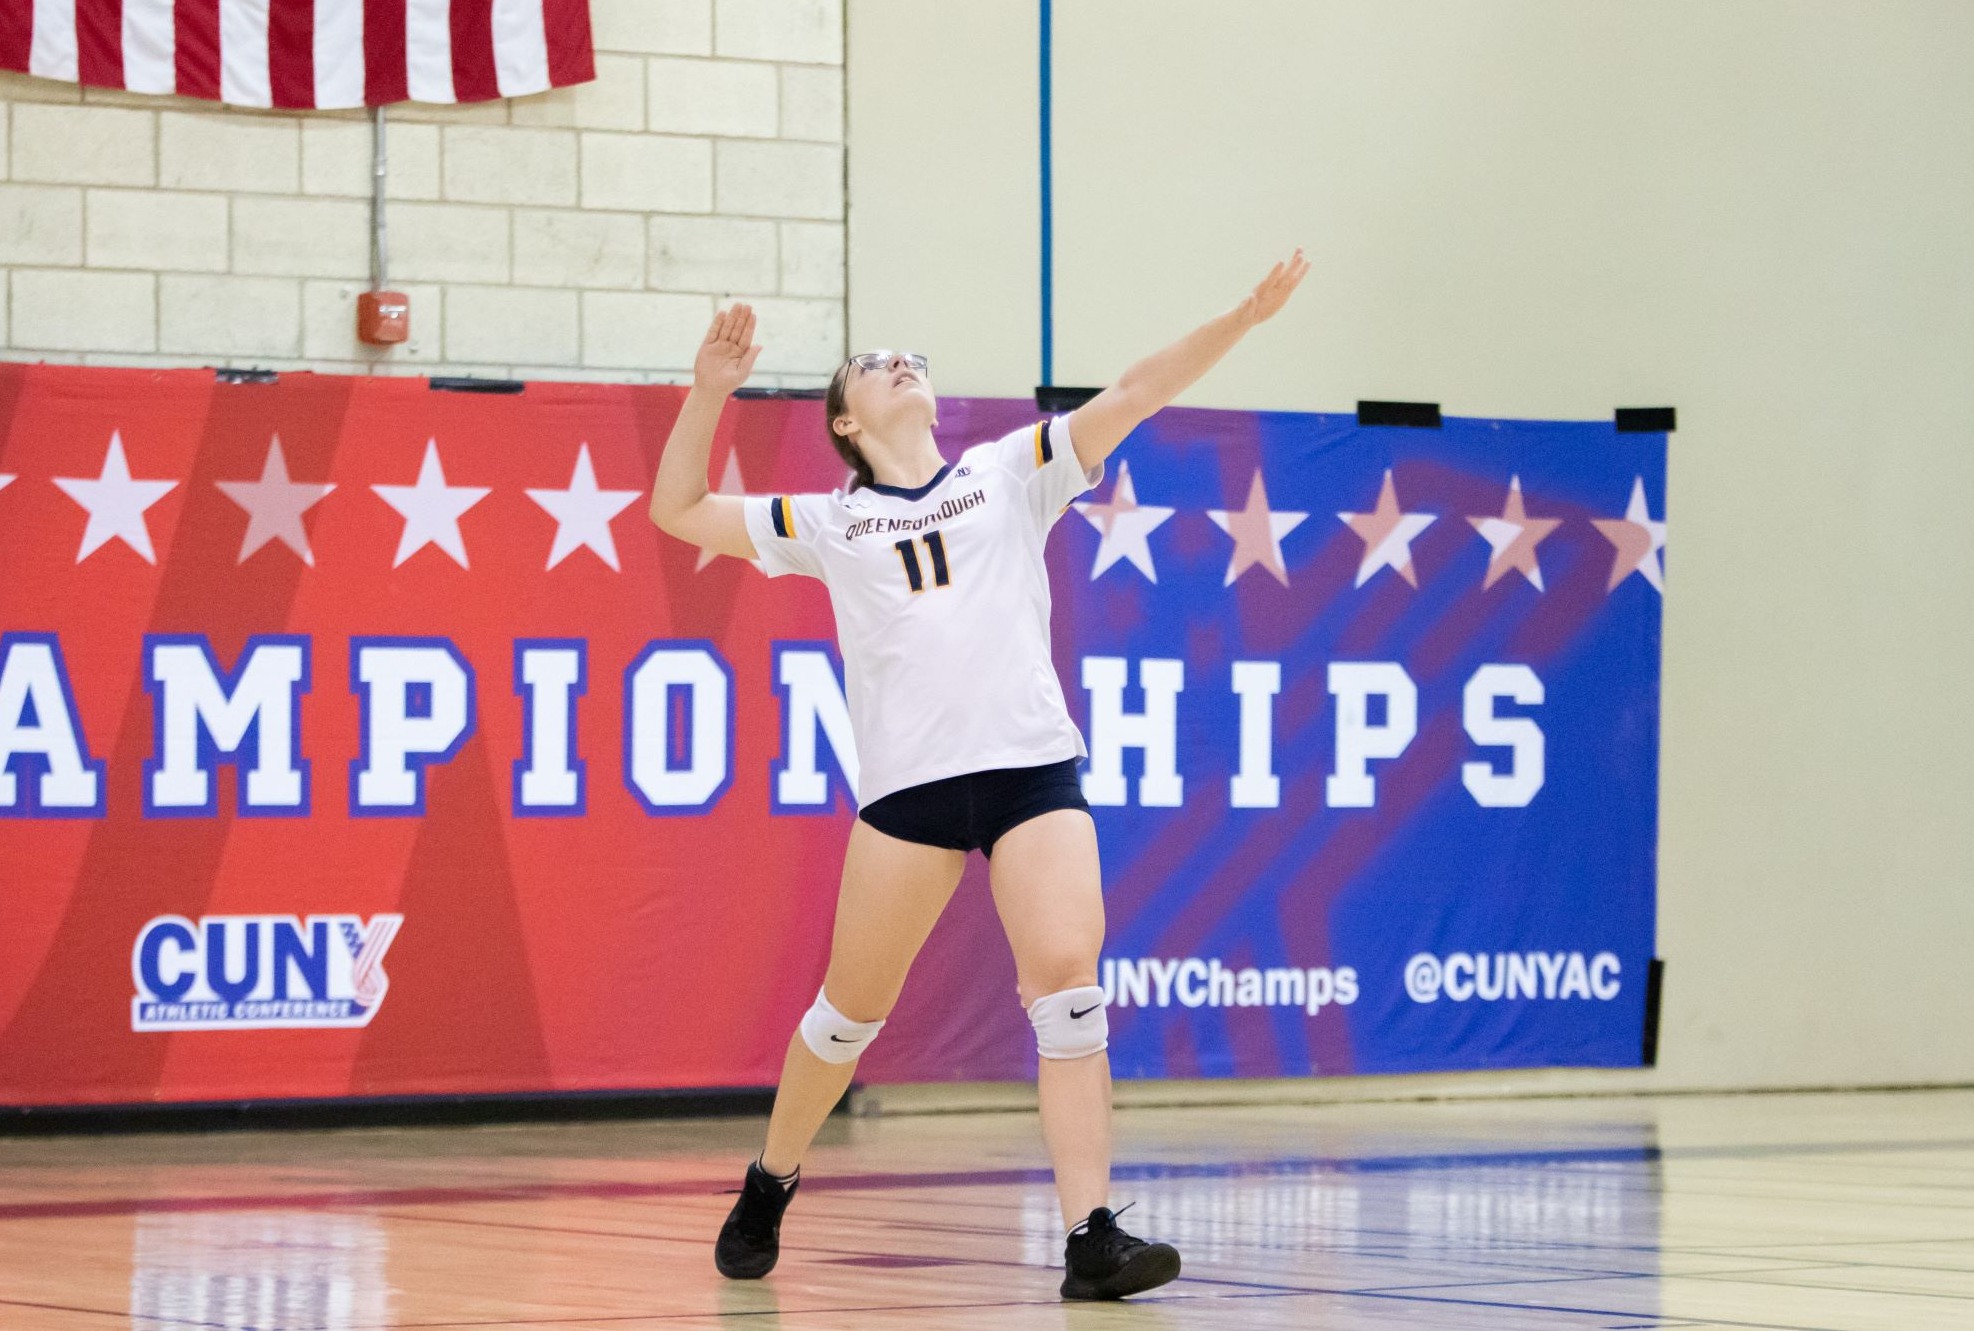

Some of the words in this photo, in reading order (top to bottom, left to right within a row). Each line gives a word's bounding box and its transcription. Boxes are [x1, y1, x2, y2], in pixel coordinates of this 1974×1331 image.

[893, 529, 952, 593] 11
[0, 633, 1546, 816] AMPIONHIPS
[139, 920, 400, 1004] CUNY
[1403, 951, 1622, 1003] @CUNYAC
[144, 1002, 229, 1020] ATHLETIC
[233, 1000, 350, 1019] CONFERENCE
